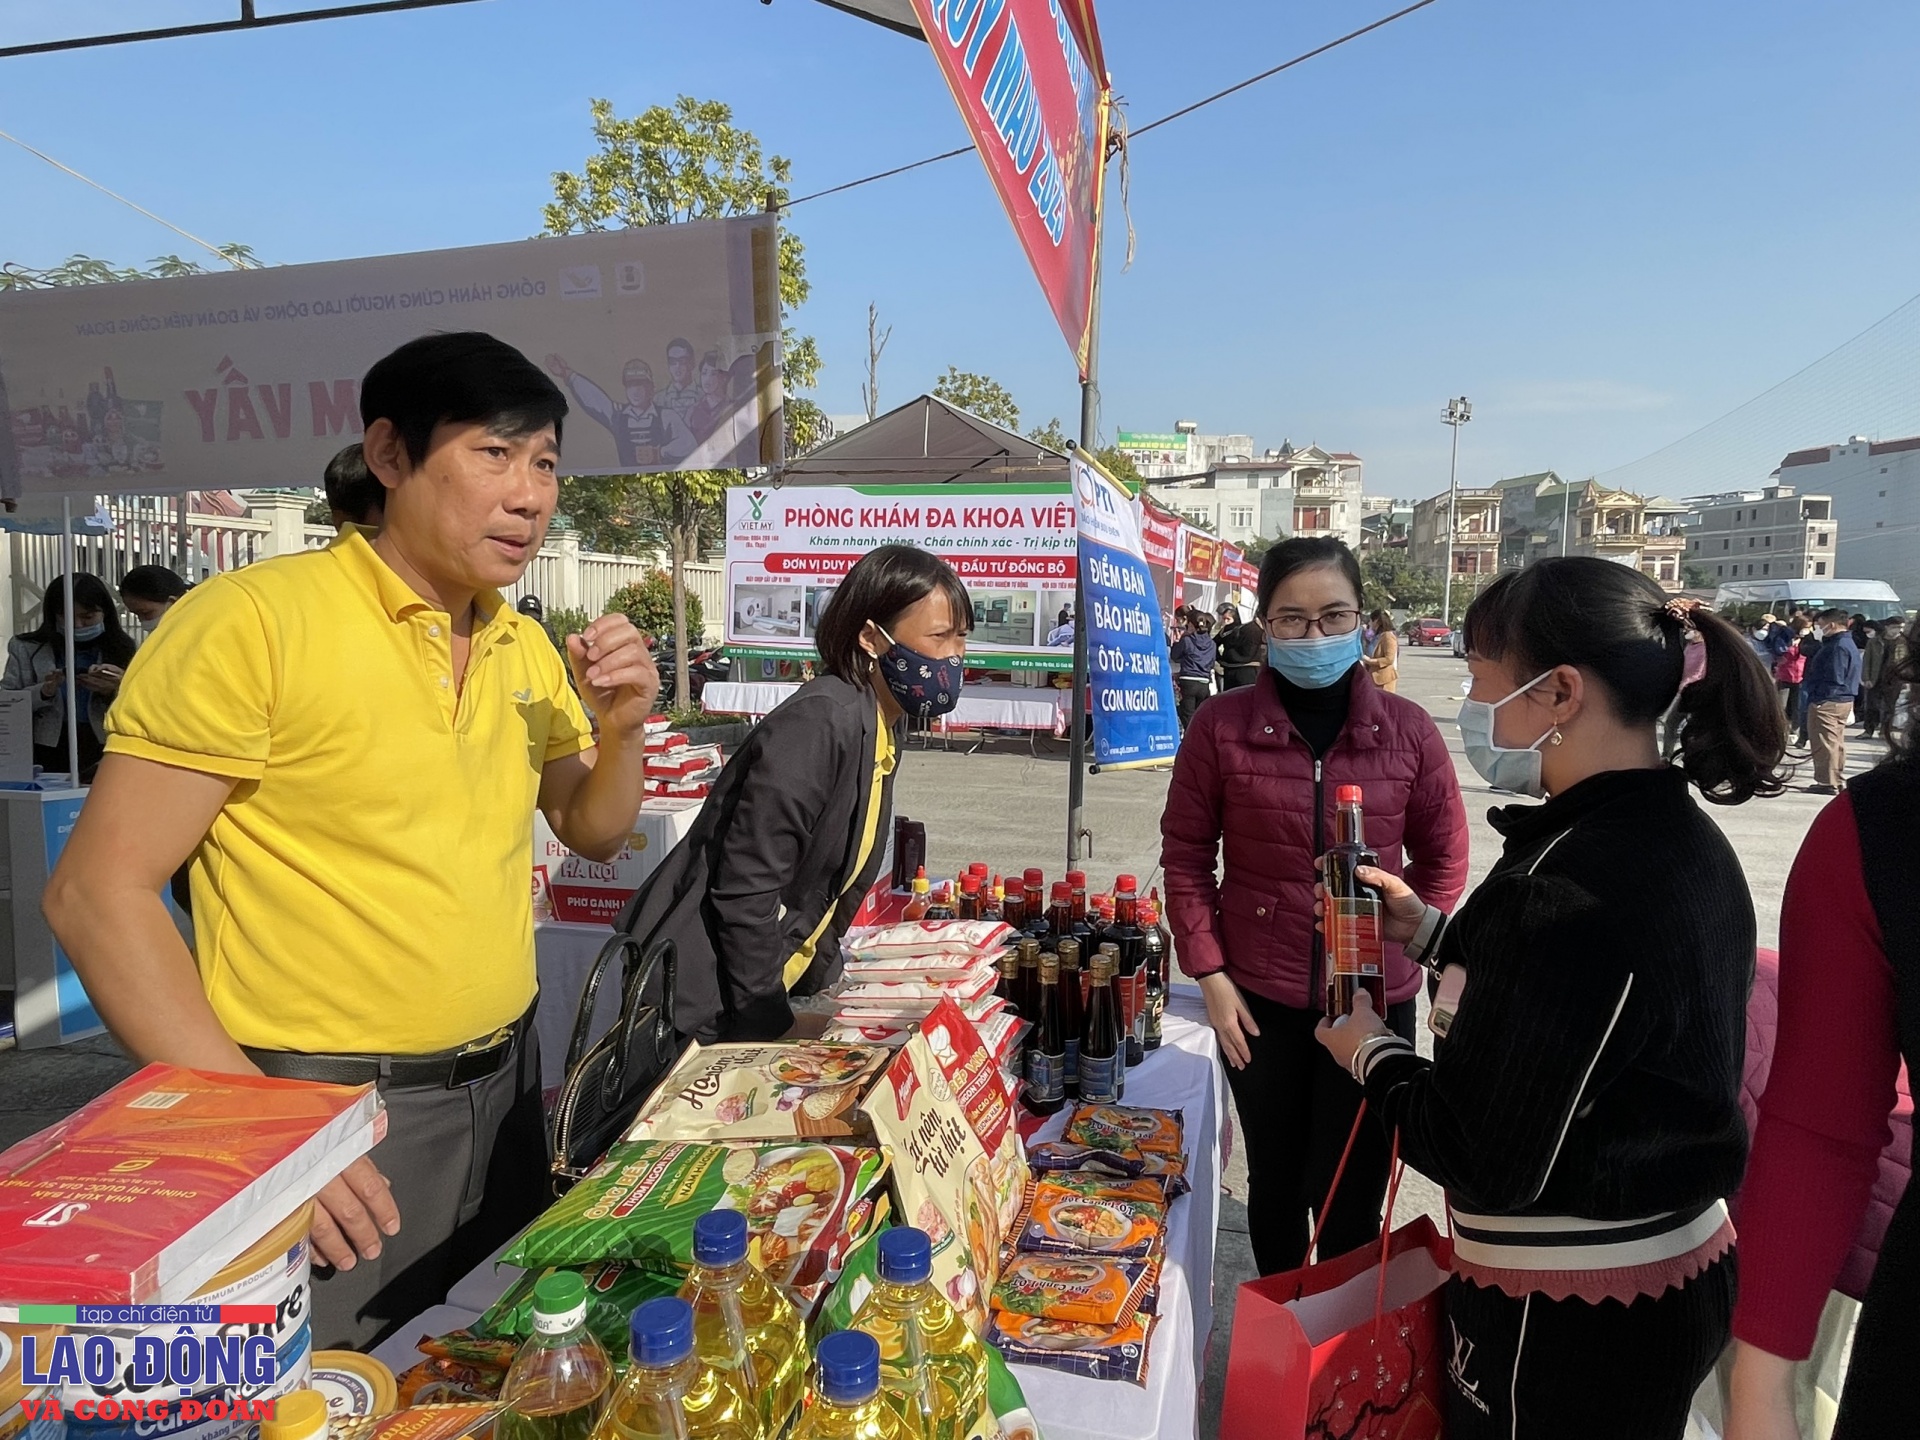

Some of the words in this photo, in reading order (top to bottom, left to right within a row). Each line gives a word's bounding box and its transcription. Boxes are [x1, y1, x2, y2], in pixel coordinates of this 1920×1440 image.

[1094, 483, 1115, 514] PTI
[785, 503, 854, 528] PHÒNG
[860, 503, 920, 528] KHÁM
[925, 507, 957, 528] ĐA
[963, 507, 1024, 528] KHOA
[809, 535, 840, 547] Khám
[843, 535, 877, 547] nhanh
[956, 535, 988, 549] chính
[991, 536, 1013, 548] xác
[1023, 536, 1040, 551] Trị
[1041, 536, 1061, 551] kịp
[782, 559, 806, 571] ĐƠN
[809, 560, 820, 573] VỊ
[822, 561, 844, 571] DUY
[990, 560, 1008, 573] TƯ
[1047, 560, 1066, 576] BỘ
[1089, 553, 1122, 591] ĐIỂM
[1094, 596, 1121, 632] BẢO
[1123, 601, 1152, 637] HIỂM
[1098, 644, 1108, 672] Ô
[1108, 646, 1125, 673] TÔ
[1129, 652, 1144, 675] XE
[1143, 651, 1161, 676] MÁY
[1101, 688, 1125, 712] CON
[1125, 685, 1160, 712] NGƯỜI
[561, 859, 586, 878] HÀ
[60, 1182, 83, 1190] GIA
[104, 1194, 137, 1204] NHÀ
[236, 1265, 274, 1290] PRODUCT
